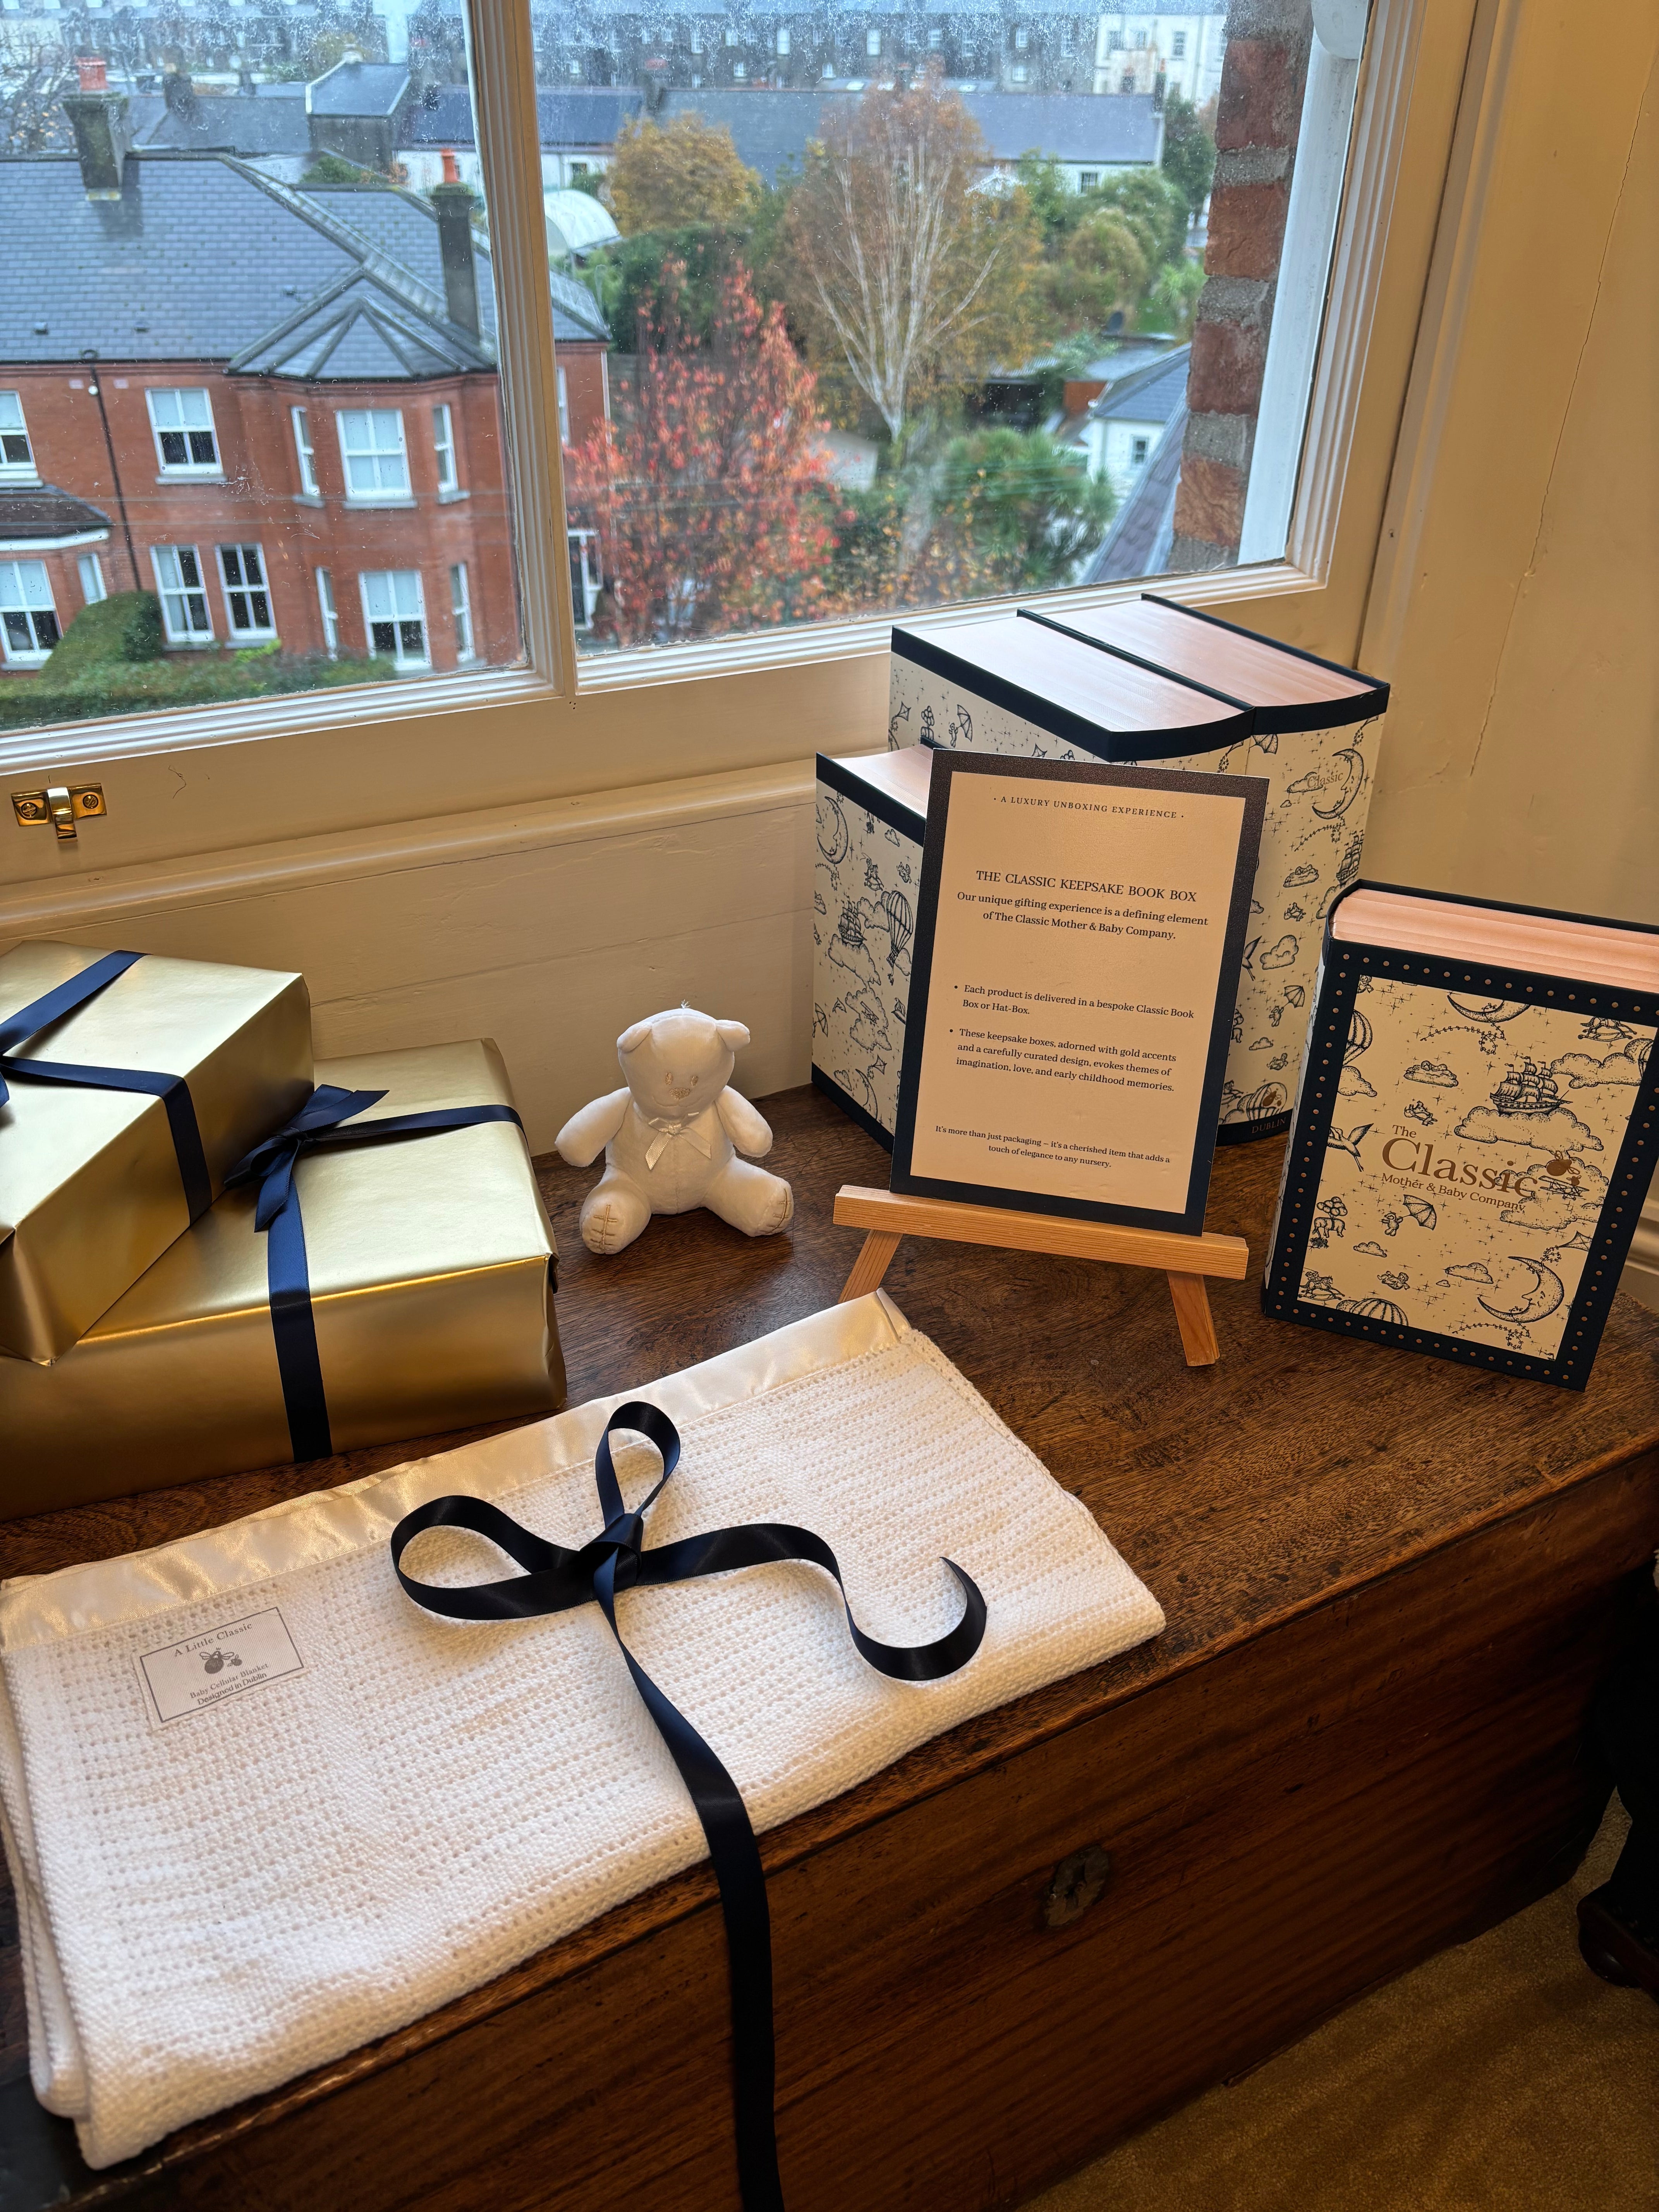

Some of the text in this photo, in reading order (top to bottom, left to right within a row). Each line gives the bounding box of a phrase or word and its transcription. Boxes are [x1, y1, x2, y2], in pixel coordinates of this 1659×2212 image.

[1307, 773, 1343, 788] Classic
[1010, 797, 1050, 807] LUXURY
[1054, 800, 1107, 812] UNBOXING
[1112, 806, 1176, 818] EXPERIENCE
[976, 870, 1197, 902] THE CLASSIC KEEPSAKE BOOK BOX
[957, 892, 977, 901] Our
[979, 895, 1013, 906] unique
[1014, 898, 1047, 911] gifting
[1049, 903, 1102, 914] experience
[1104, 907, 1113, 915] is
[1122, 908, 1166, 923] defining
[1167, 913, 1209, 926] element
[983, 911, 1176, 941] of The Classic Mother & Baby Company.
[962, 999, 979, 1008] Box
[992, 1003, 1030, 1014] Hat-Box.
[964, 984, 985, 994] Each
[987, 989, 1023, 999] product
[1024, 991, 1032, 1000] is
[1034, 993, 1076, 1005] delivered
[1078, 998, 1087, 1006] in
[1096, 1000, 1134, 1012] bespoke
[1136, 1005, 1169, 1015] Classic
[1170, 1008, 1194, 1018] Book
[957, 1044, 974, 1052] and
[983, 1048, 1023, 1059] carefully
[1024, 1053, 1058, 1062] curated
[1060, 1055, 1091, 1067] design,
[1093, 1061, 1124, 1070] evokes
[1126, 1063, 1159, 1075] themes
[959, 1028, 1176, 1061] These keepsake boxes, adorned with gold accents
[956, 1057, 1011, 1072] imagination,
[1013, 1064, 1033, 1075] love,
[1054, 1071, 1077, 1081] early
[1079, 1073, 1125, 1085] childhood
[1126, 1080, 1174, 1091] memories.
[1252, 1117, 1286, 1133] DUBLIN
[1392, 1125, 1417, 1138] The
[969, 1130, 986, 1138] than
[987, 1132, 1002, 1140] just
[1003, 1136, 1041, 1147] packaging
[1069, 1144, 1107, 1154] cherished
[1109, 1149, 1126, 1157] item
[1128, 1151, 1144, 1159] that
[1145, 1154, 1164, 1162] adds
[989, 1145, 1010, 1154] touch
[1020, 1149, 1054, 1159] elegance
[1080, 1158, 1111, 1168] nursery.
[1382, 1138, 1538, 1197] Classic
[1381, 1173, 1526, 1213] Mother & Baby Company
[175, 1623, 252, 1657] A Little Classic
[190, 1663, 269, 1698] Baby Cellular Blanket
[197, 1685, 234, 1705] Designed
[242, 1673, 267, 1686] Dublin
